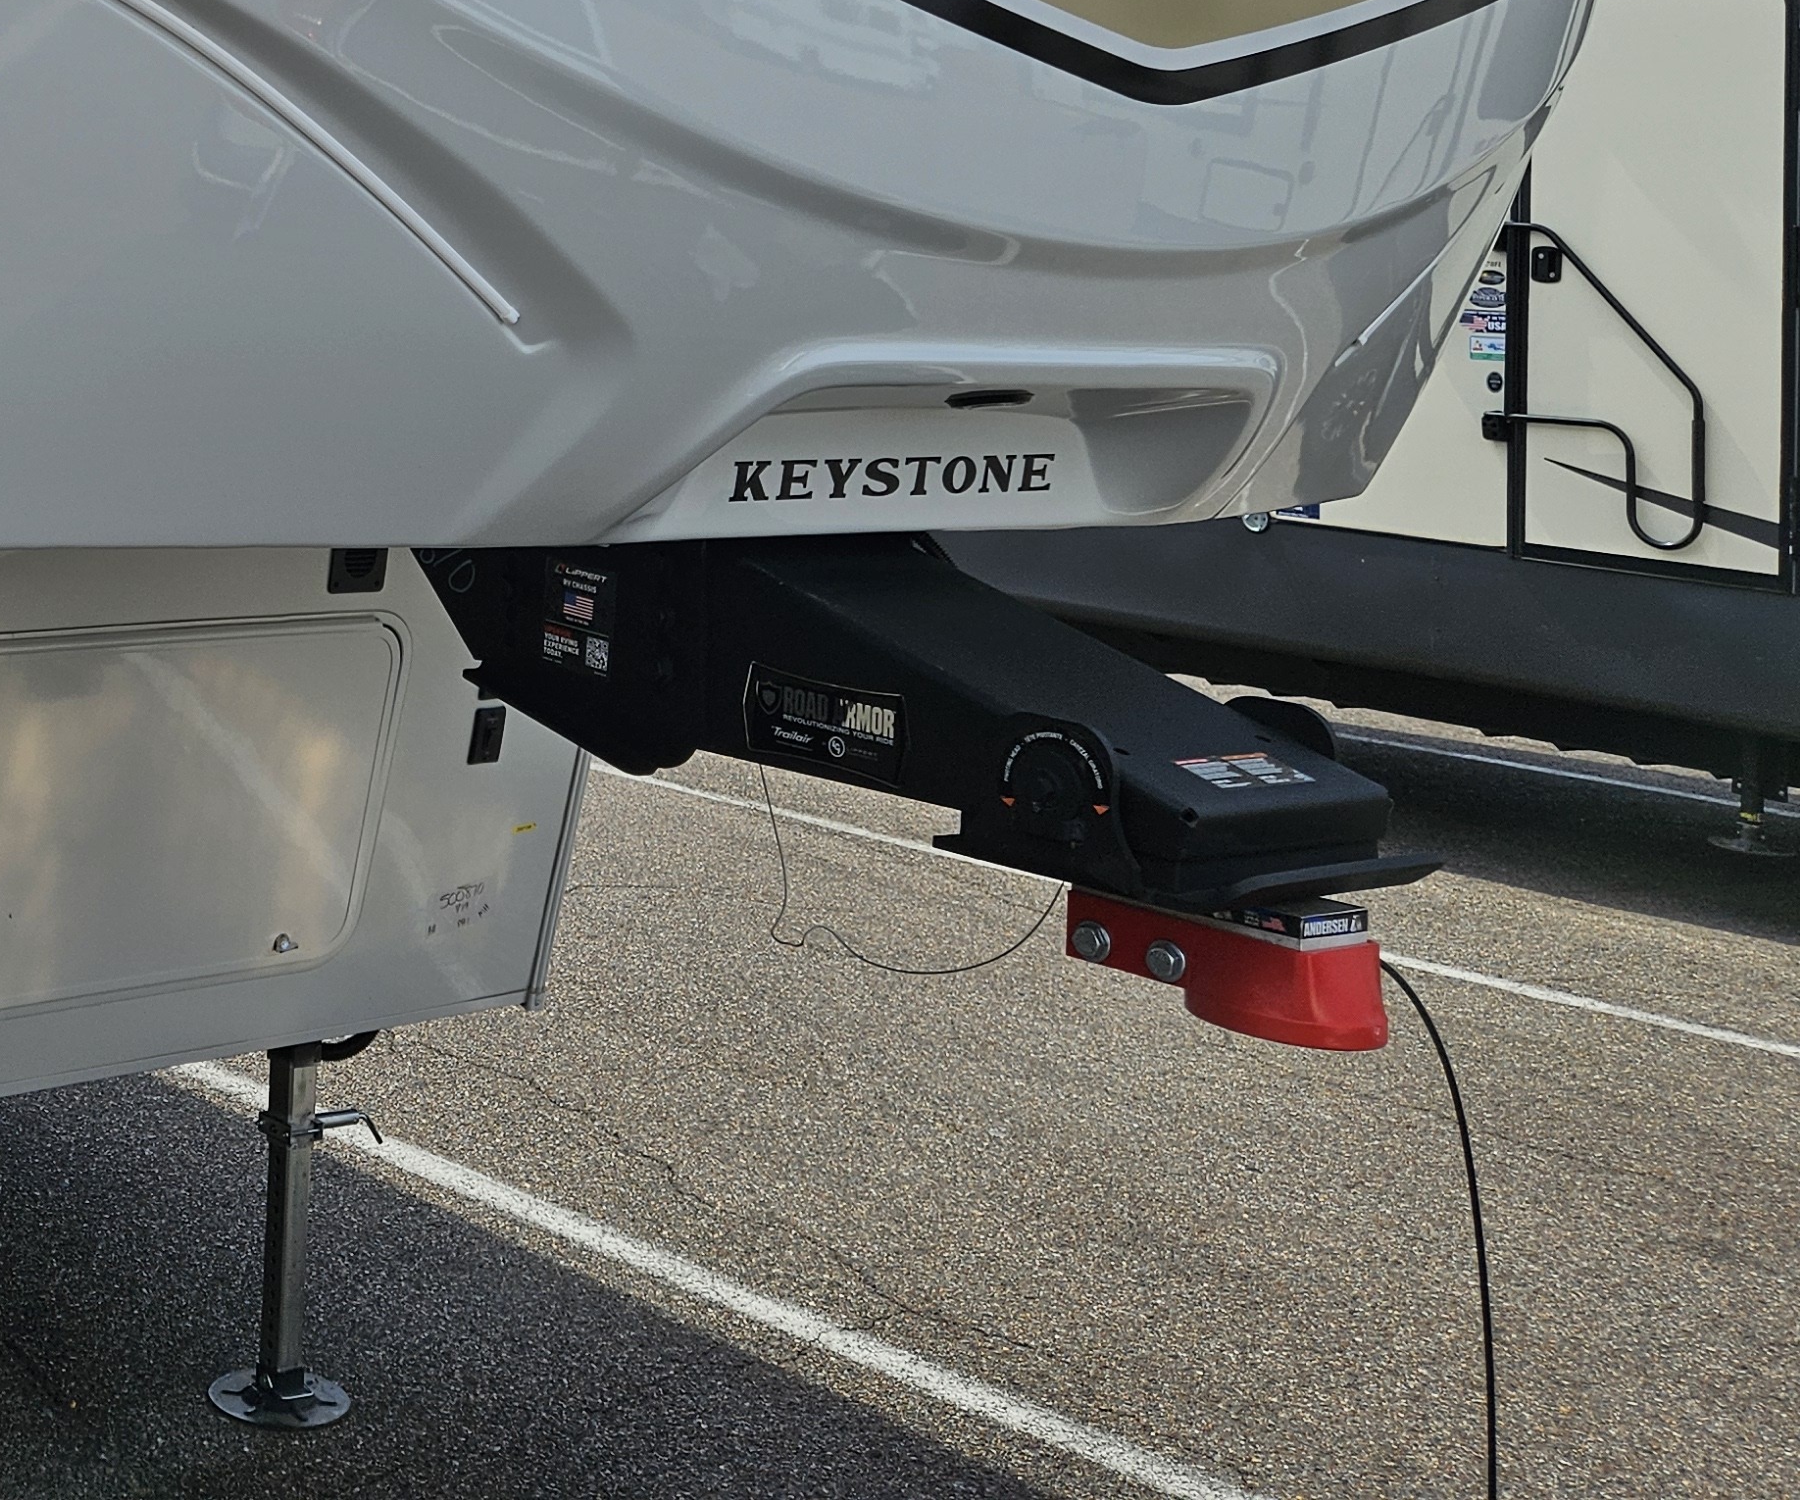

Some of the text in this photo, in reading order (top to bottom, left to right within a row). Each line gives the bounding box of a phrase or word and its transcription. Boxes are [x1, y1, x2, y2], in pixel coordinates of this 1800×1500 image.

[728, 453, 1056, 503] KEYSTONE
[565, 566, 608, 584] LIPPERT
[571, 581, 597, 594] CHASSIS
[543, 639, 580, 656] EXPERIENCE
[782, 686, 829, 724] ROAD
[771, 725, 814, 744] Trailair
[782, 713, 894, 747] REVOLUTIONIZING YOUR RIDE
[1303, 917, 1349, 938] ANDERSEN
